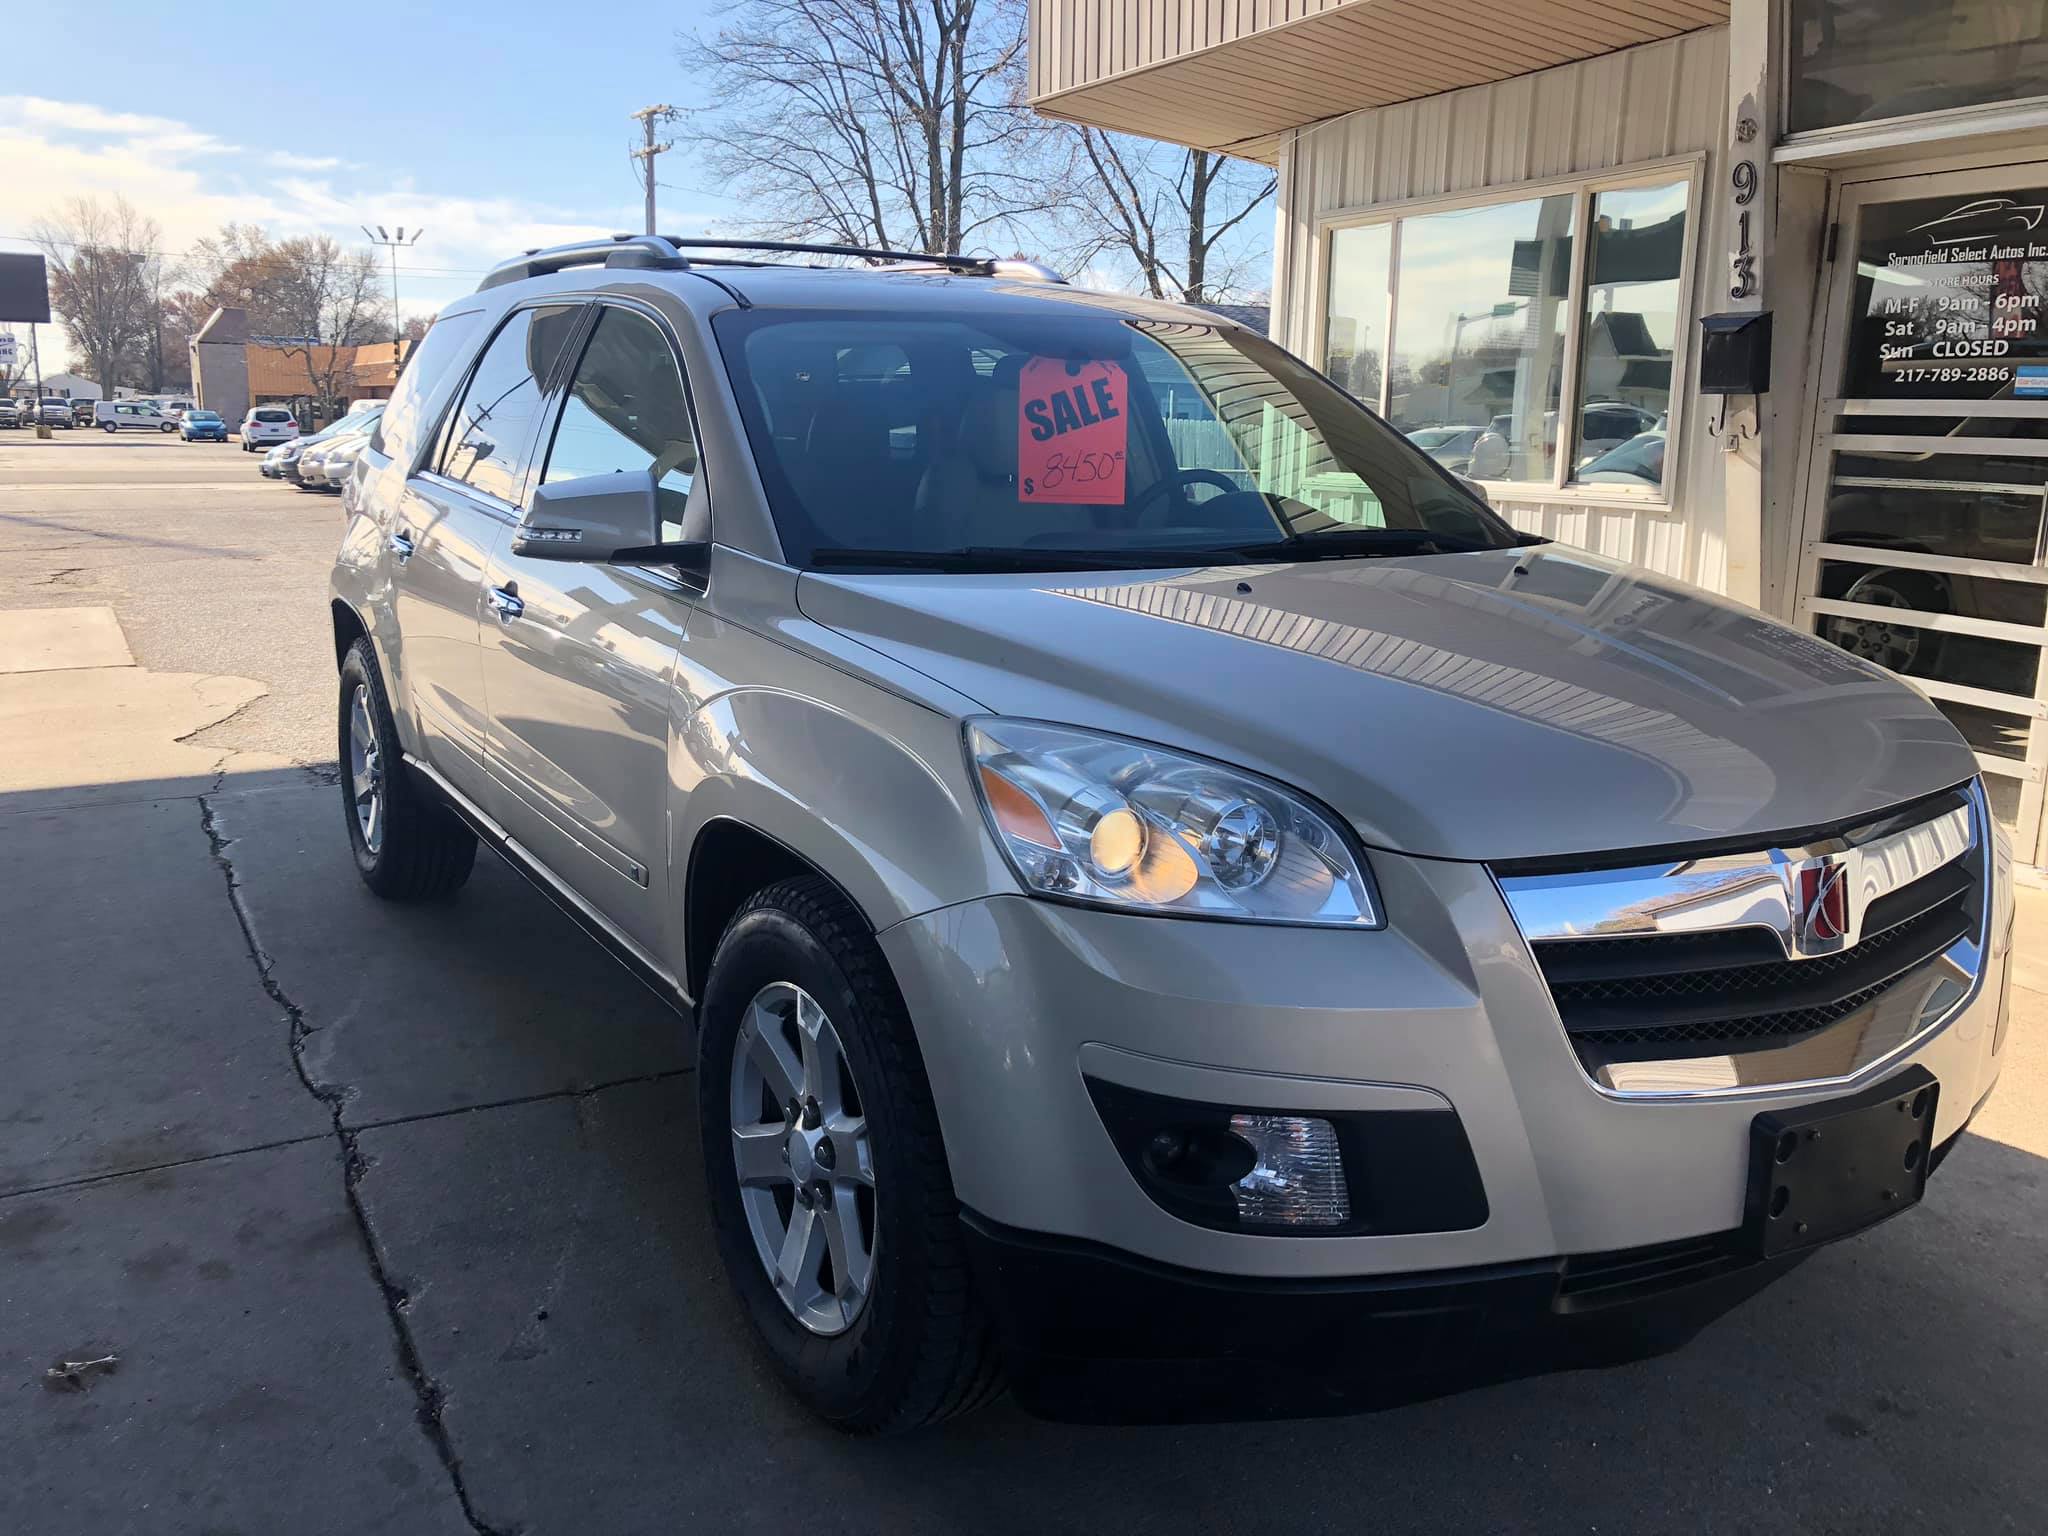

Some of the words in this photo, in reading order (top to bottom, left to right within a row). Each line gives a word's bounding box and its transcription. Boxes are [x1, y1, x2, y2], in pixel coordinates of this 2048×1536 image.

[1887, 248, 1949, 268] Springfield
[1951, 246, 1987, 263] Select
[1990, 244, 2025, 260] Autos
[1962, 273, 2000, 286] HOURS
[1884, 297, 1920, 314] M-F
[1938, 296, 1979, 312] 9am
[1994, 292, 2040, 313] 6pm
[1884, 320, 1915, 337] Sat
[1935, 319, 1976, 335] 9am
[1992, 316, 2037, 336] 4pm
[1879, 343, 1914, 360] Sun
[1932, 339, 2010, 358] CLOSED
[1894, 366, 2010, 383] 217-789-2886
[1024, 377, 1120, 442] SALE
